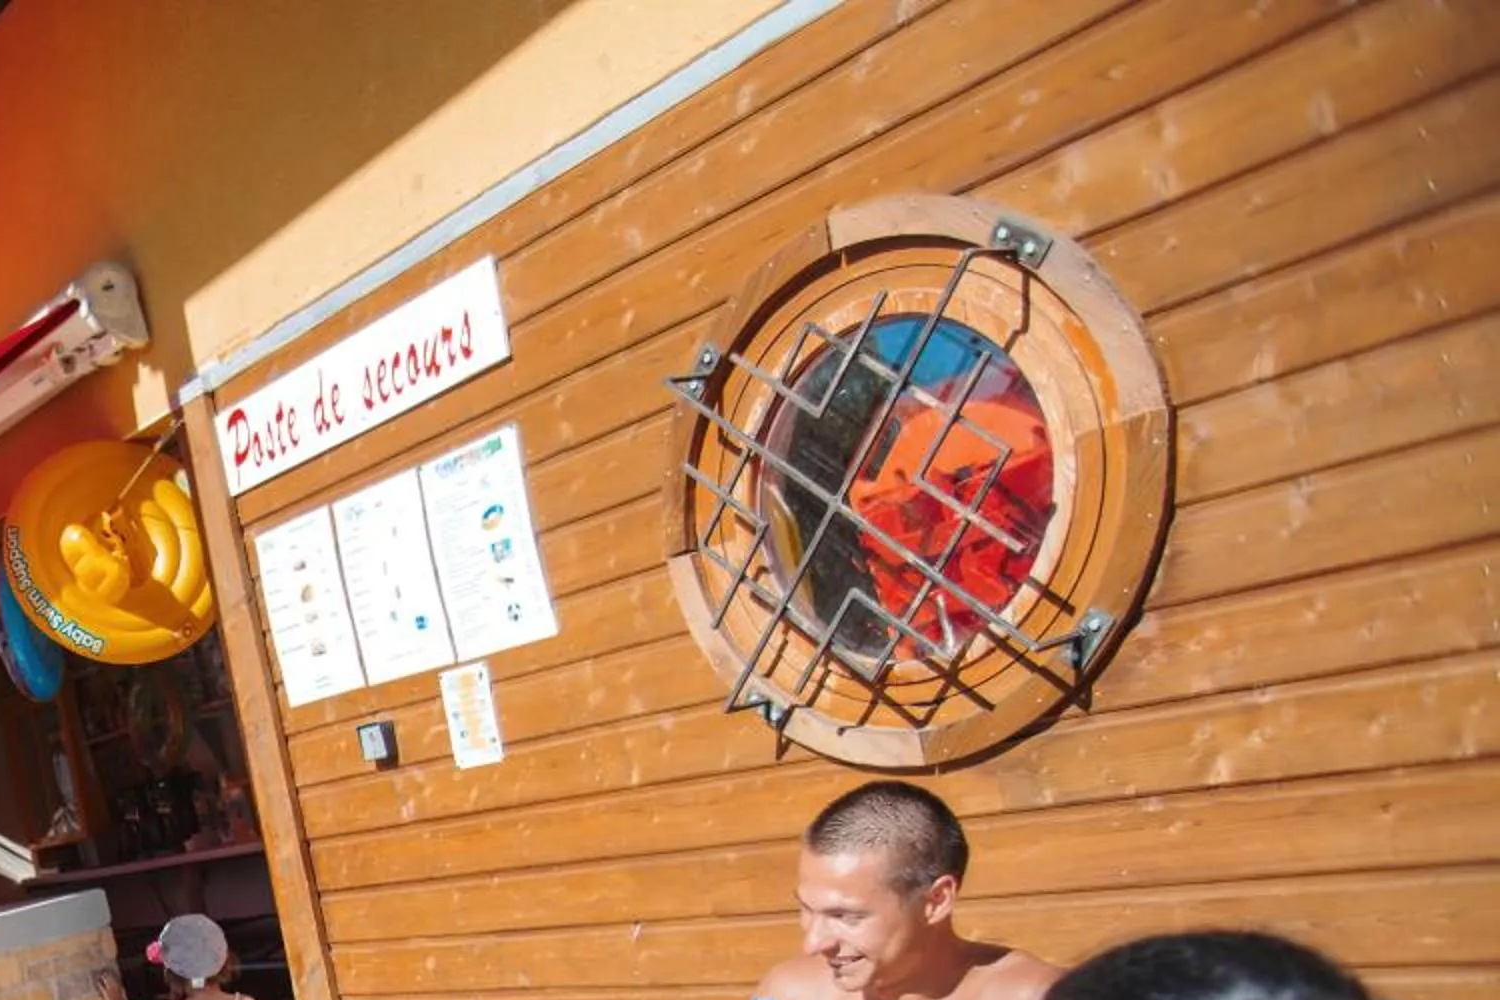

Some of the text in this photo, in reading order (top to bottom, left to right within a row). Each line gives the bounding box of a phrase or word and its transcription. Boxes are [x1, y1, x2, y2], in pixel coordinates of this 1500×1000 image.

[226, 310, 474, 488] Poste de secours
[63, 623, 105, 654] Baby
